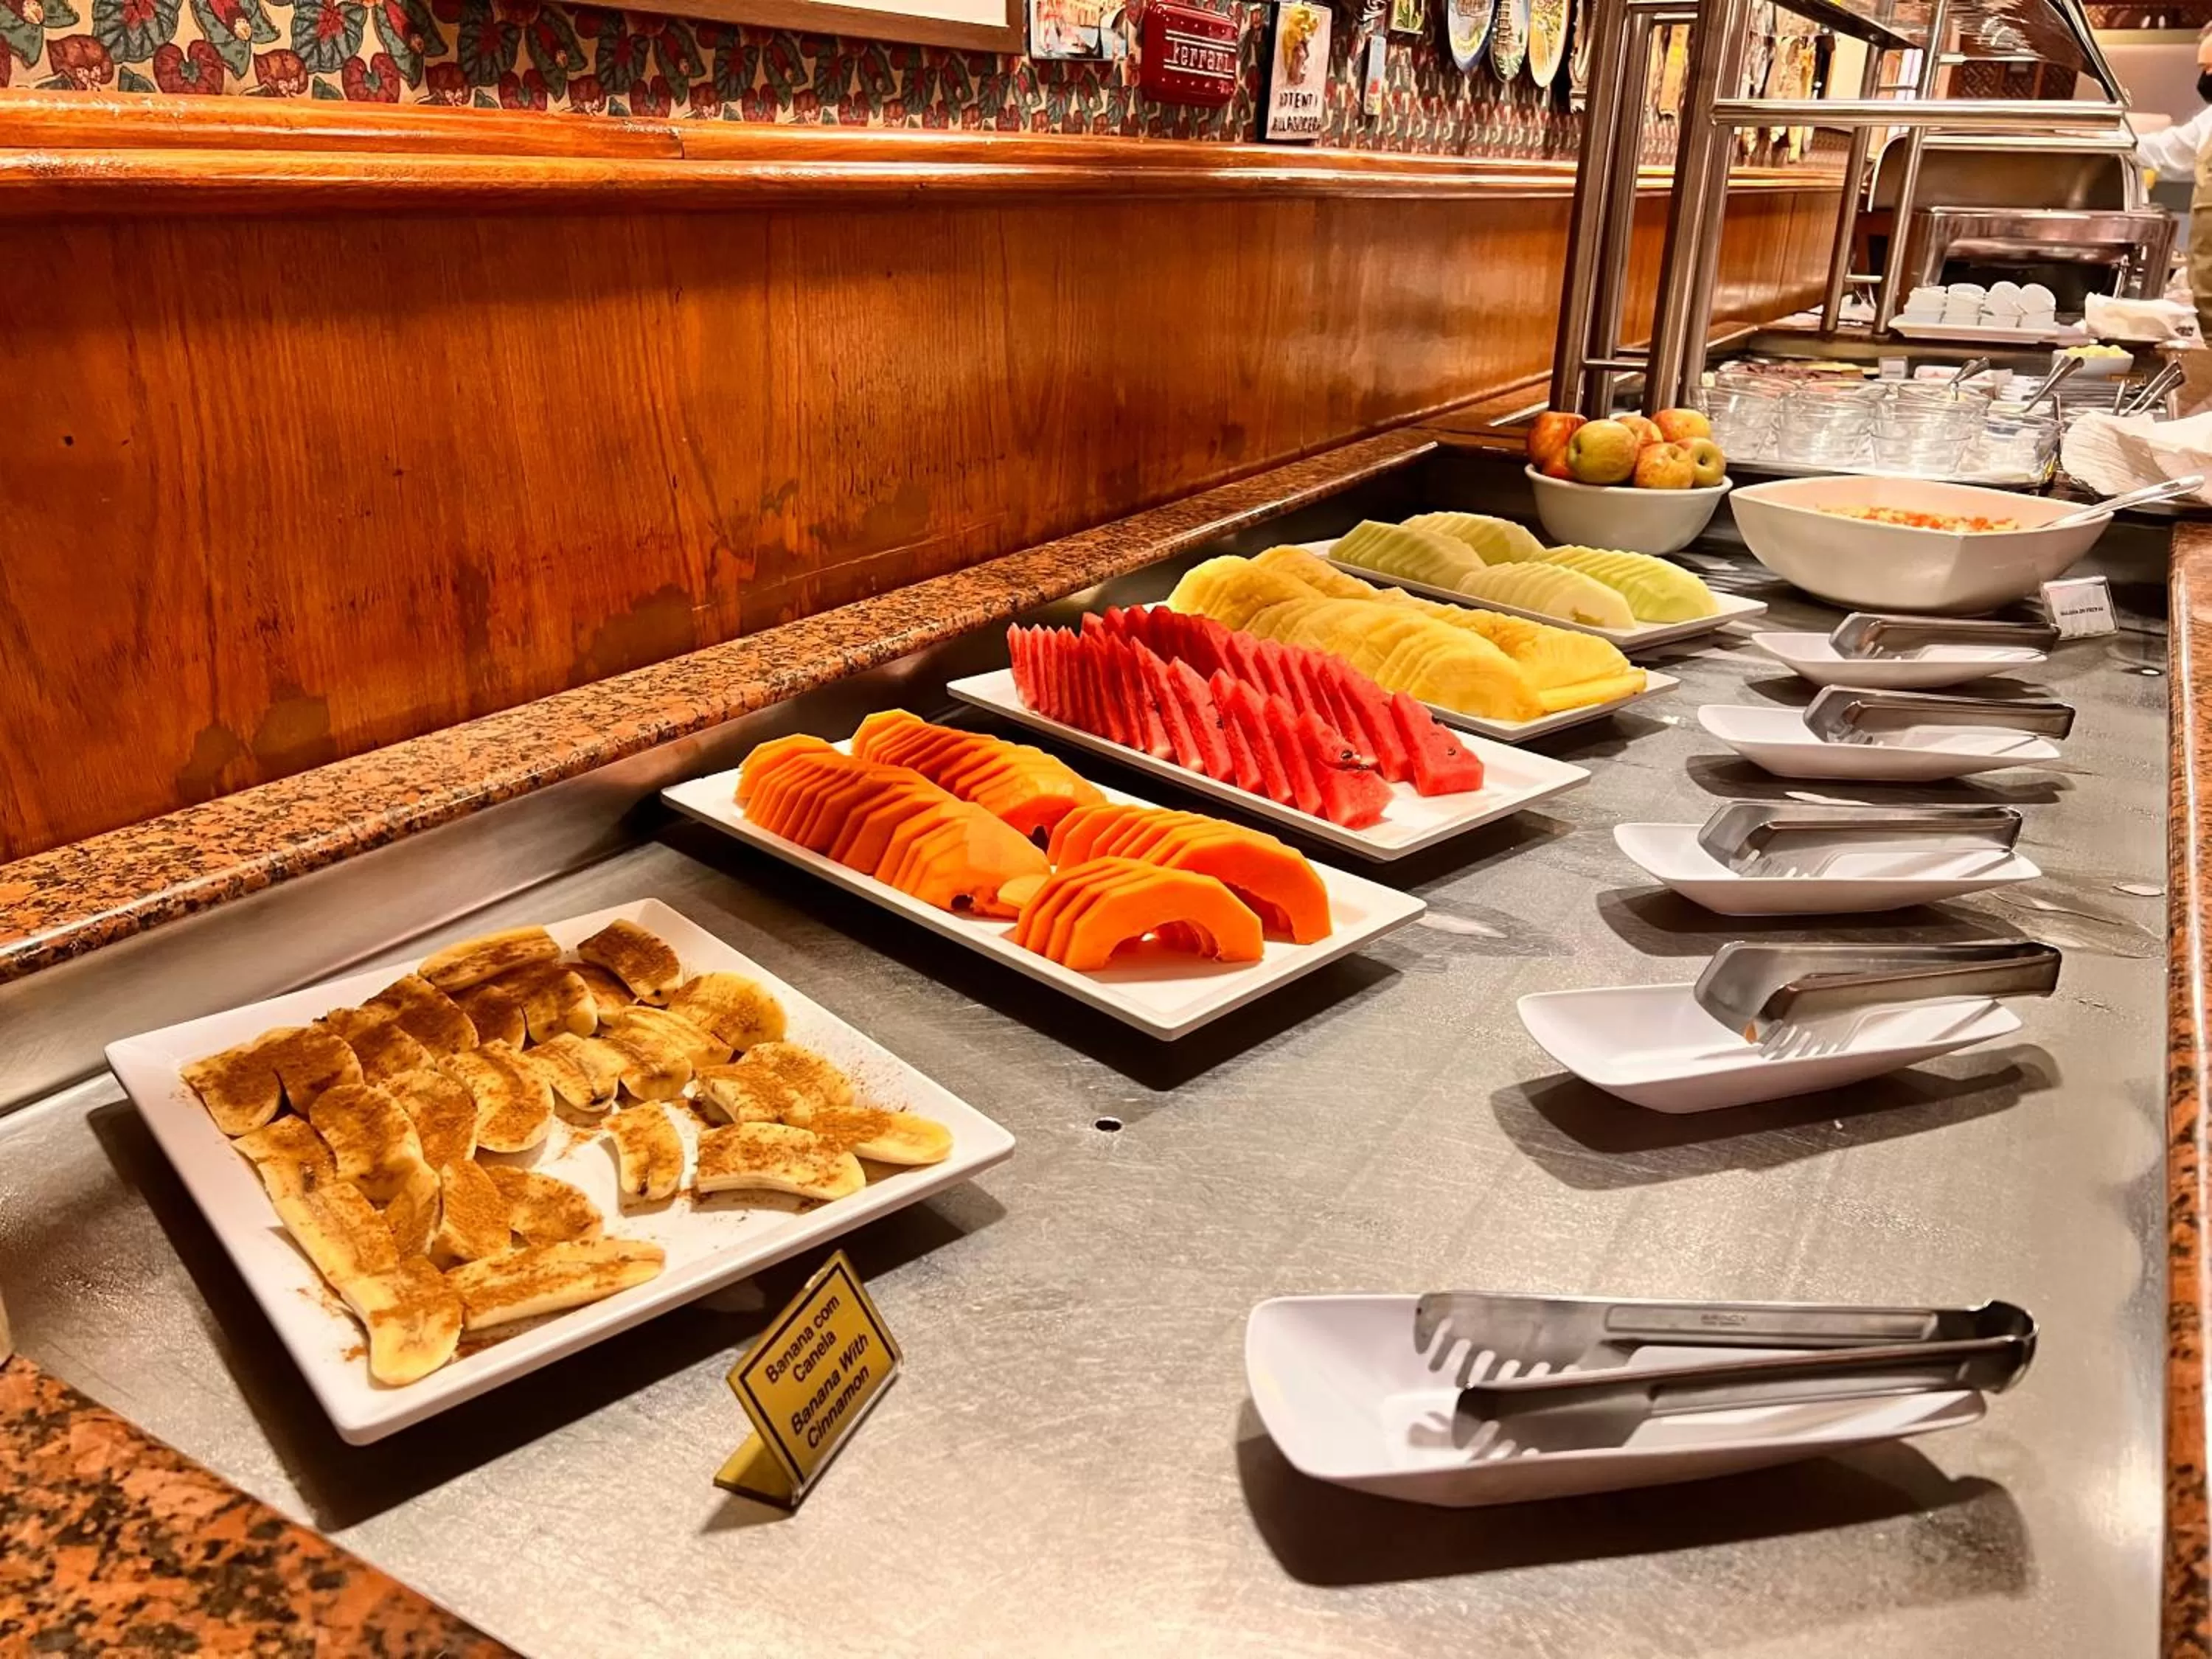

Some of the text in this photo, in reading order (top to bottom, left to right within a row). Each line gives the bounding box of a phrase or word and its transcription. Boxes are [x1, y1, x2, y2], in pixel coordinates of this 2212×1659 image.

[765, 1295, 841, 1384] Banana com
[793, 1330, 837, 1382] Canela
[790, 1332, 869, 1436] Banana With
[807, 1365, 870, 1449] Cinnamon
